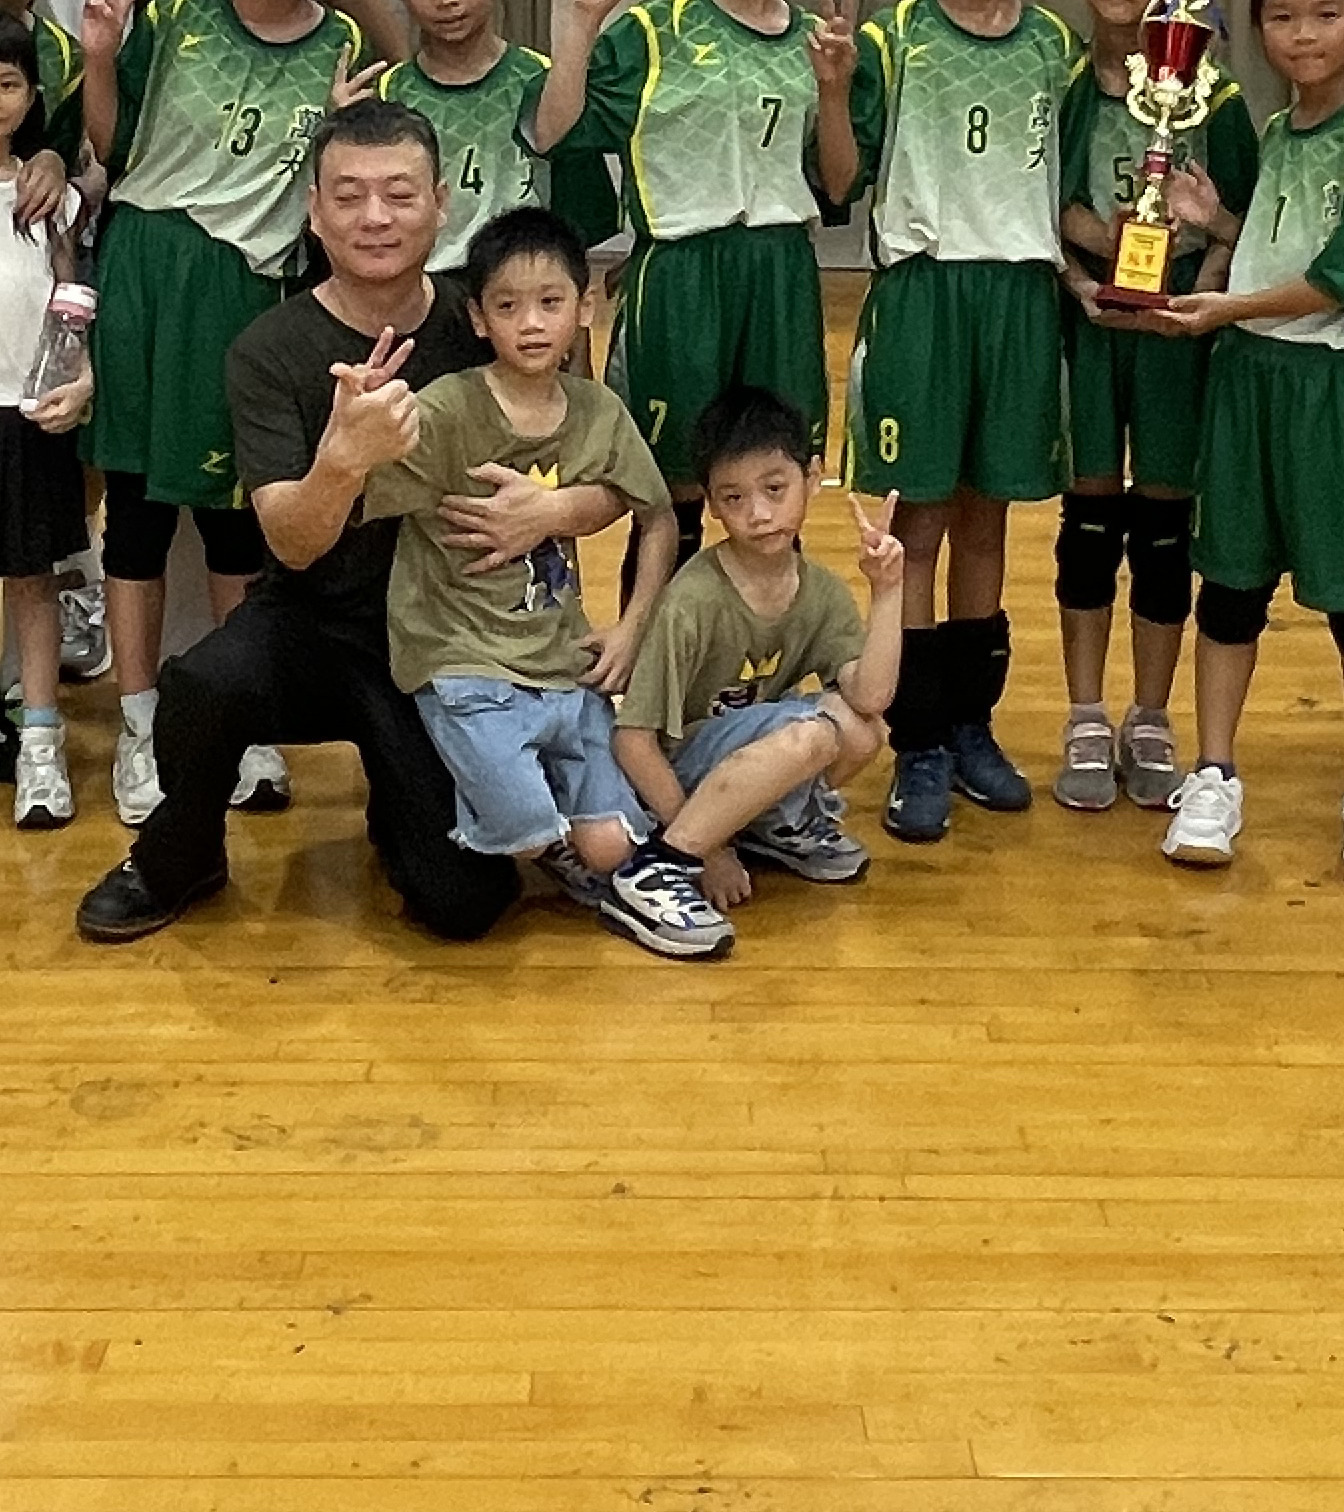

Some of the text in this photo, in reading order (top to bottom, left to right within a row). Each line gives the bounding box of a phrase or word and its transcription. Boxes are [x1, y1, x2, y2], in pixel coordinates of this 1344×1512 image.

[757, 94, 786, 150] 7
[964, 103, 992, 157] 8
[458, 144, 486, 196] 4
[1112, 155, 1136, 204] 5
[1270, 194, 1290, 244] 1
[648, 398, 668, 446] 7
[878, 417, 900, 465] 8
